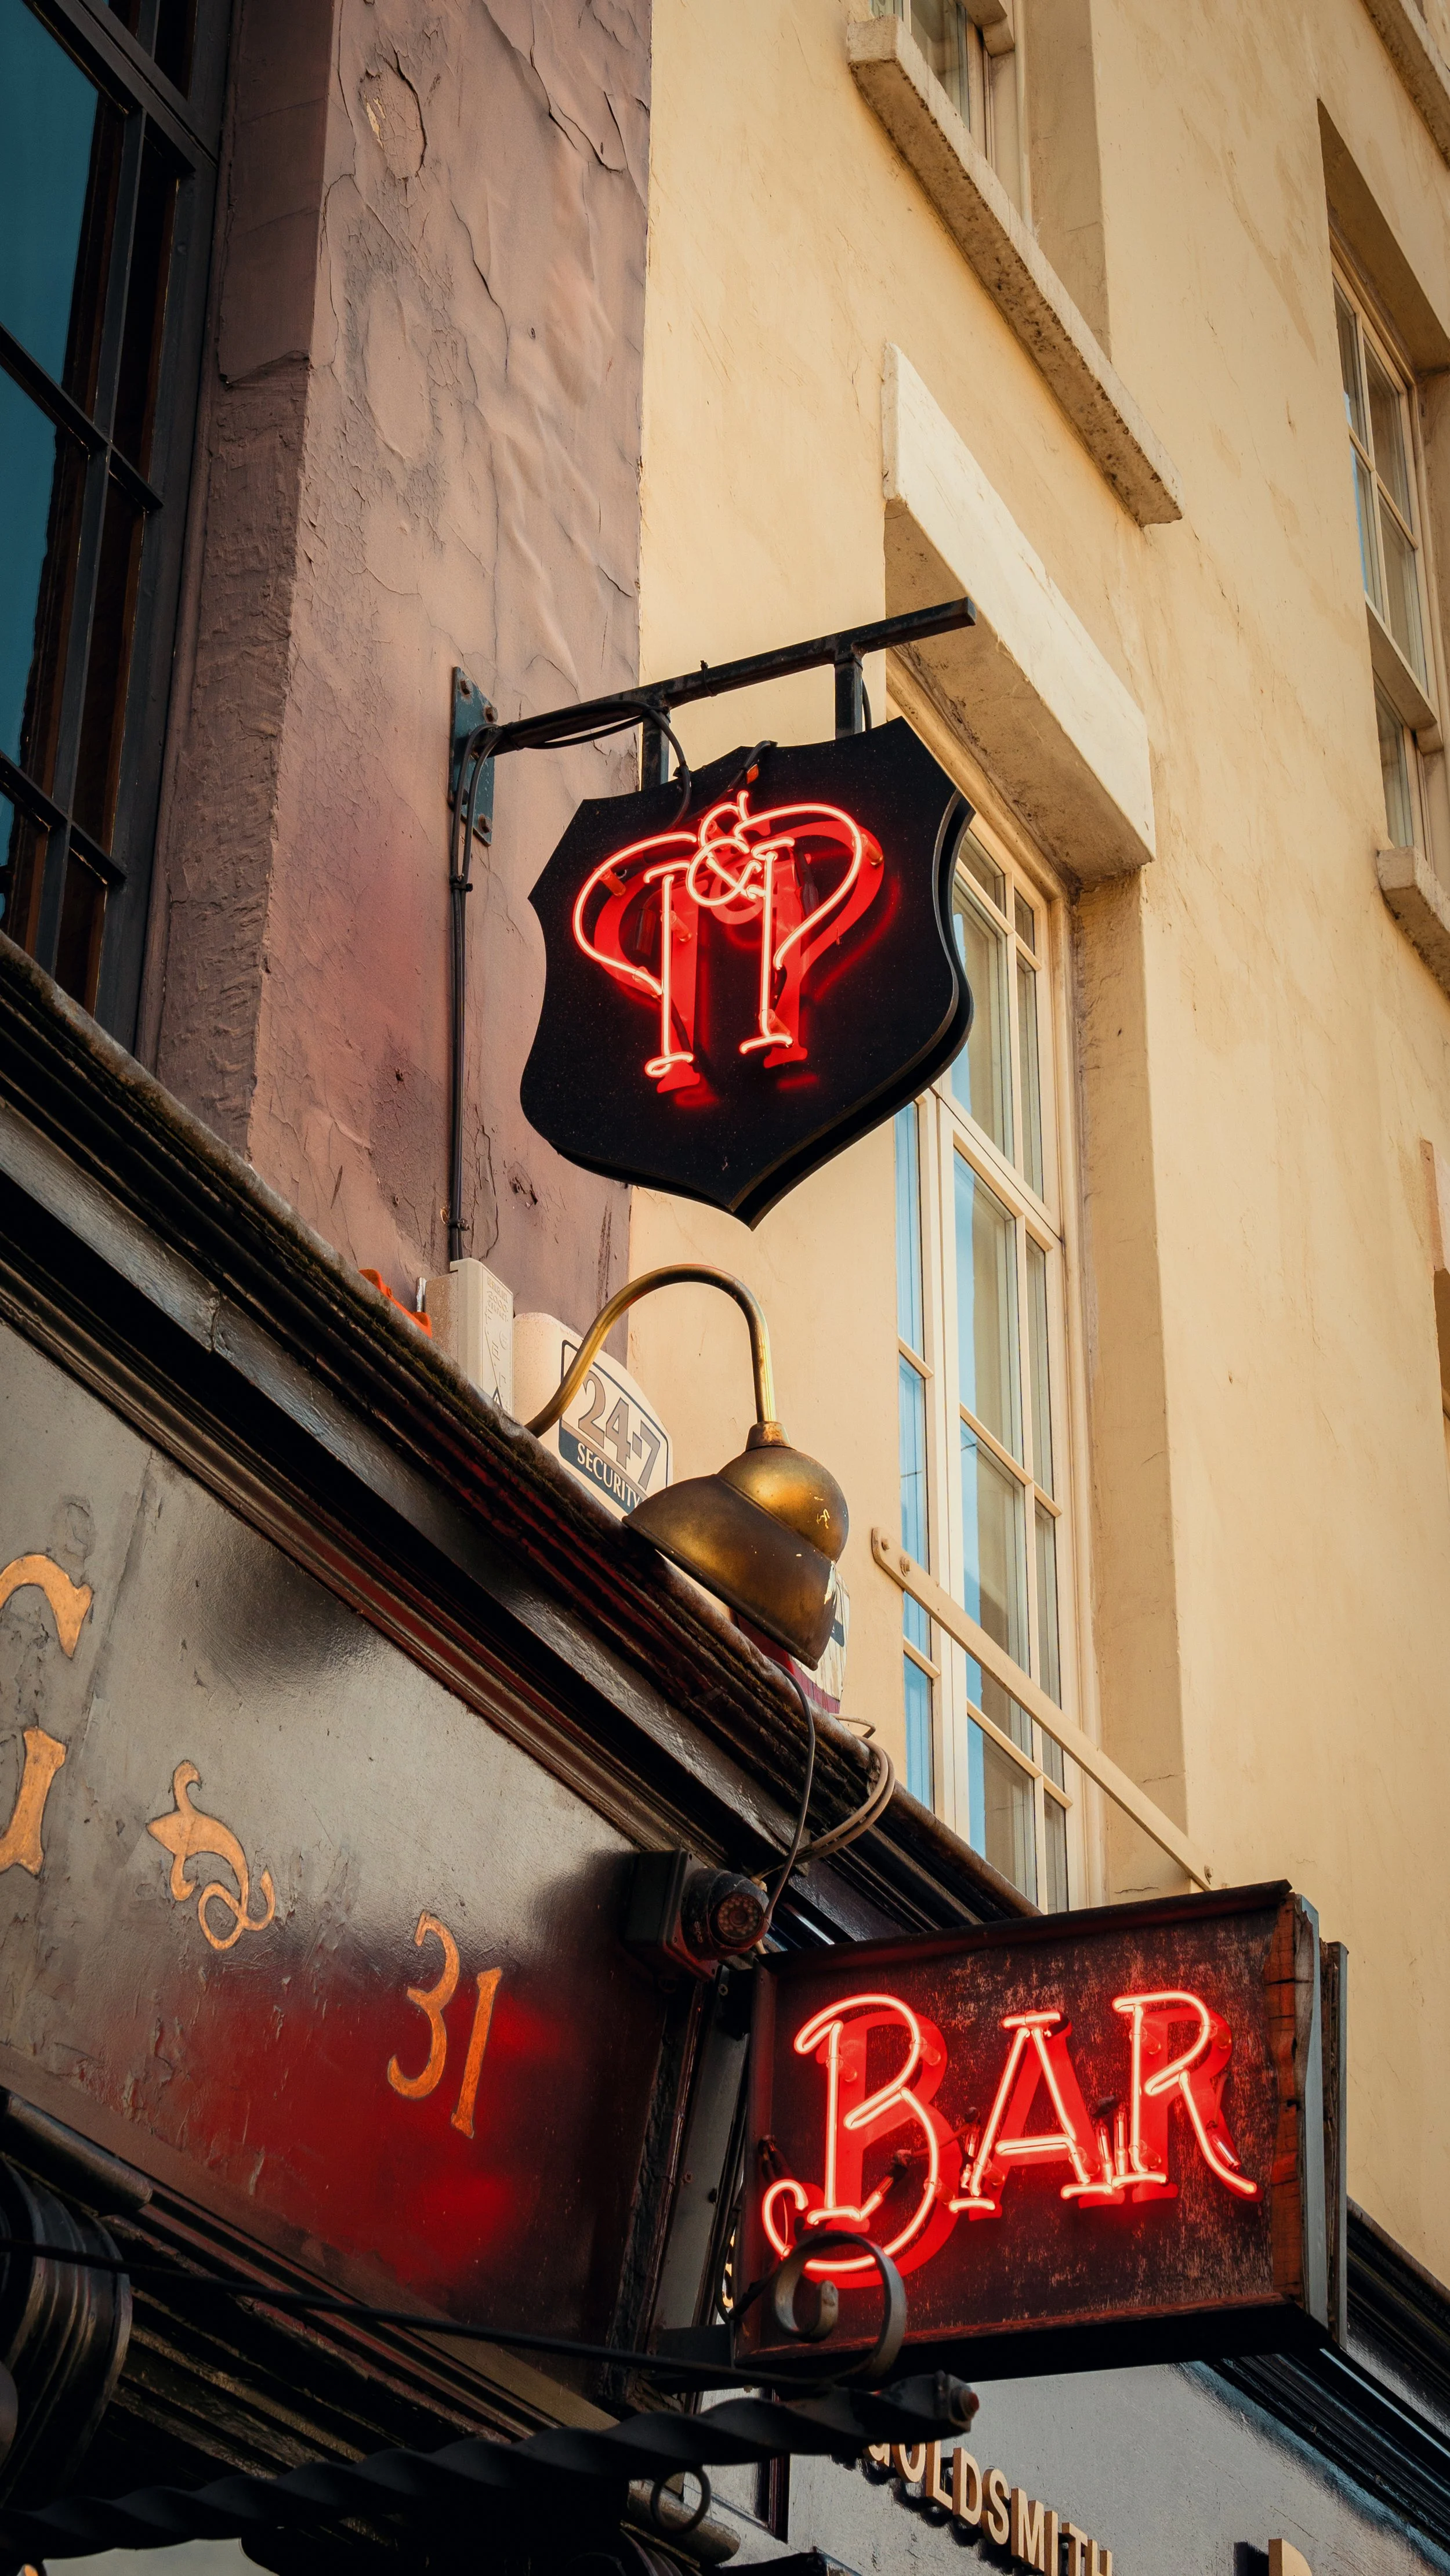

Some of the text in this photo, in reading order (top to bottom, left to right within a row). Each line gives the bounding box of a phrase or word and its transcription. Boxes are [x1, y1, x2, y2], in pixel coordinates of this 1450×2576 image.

[577, 1442, 641, 1508] SECURITY
[387, 1910, 502, 2139] 31
[762, 1990, 1260, 2276] BAR
